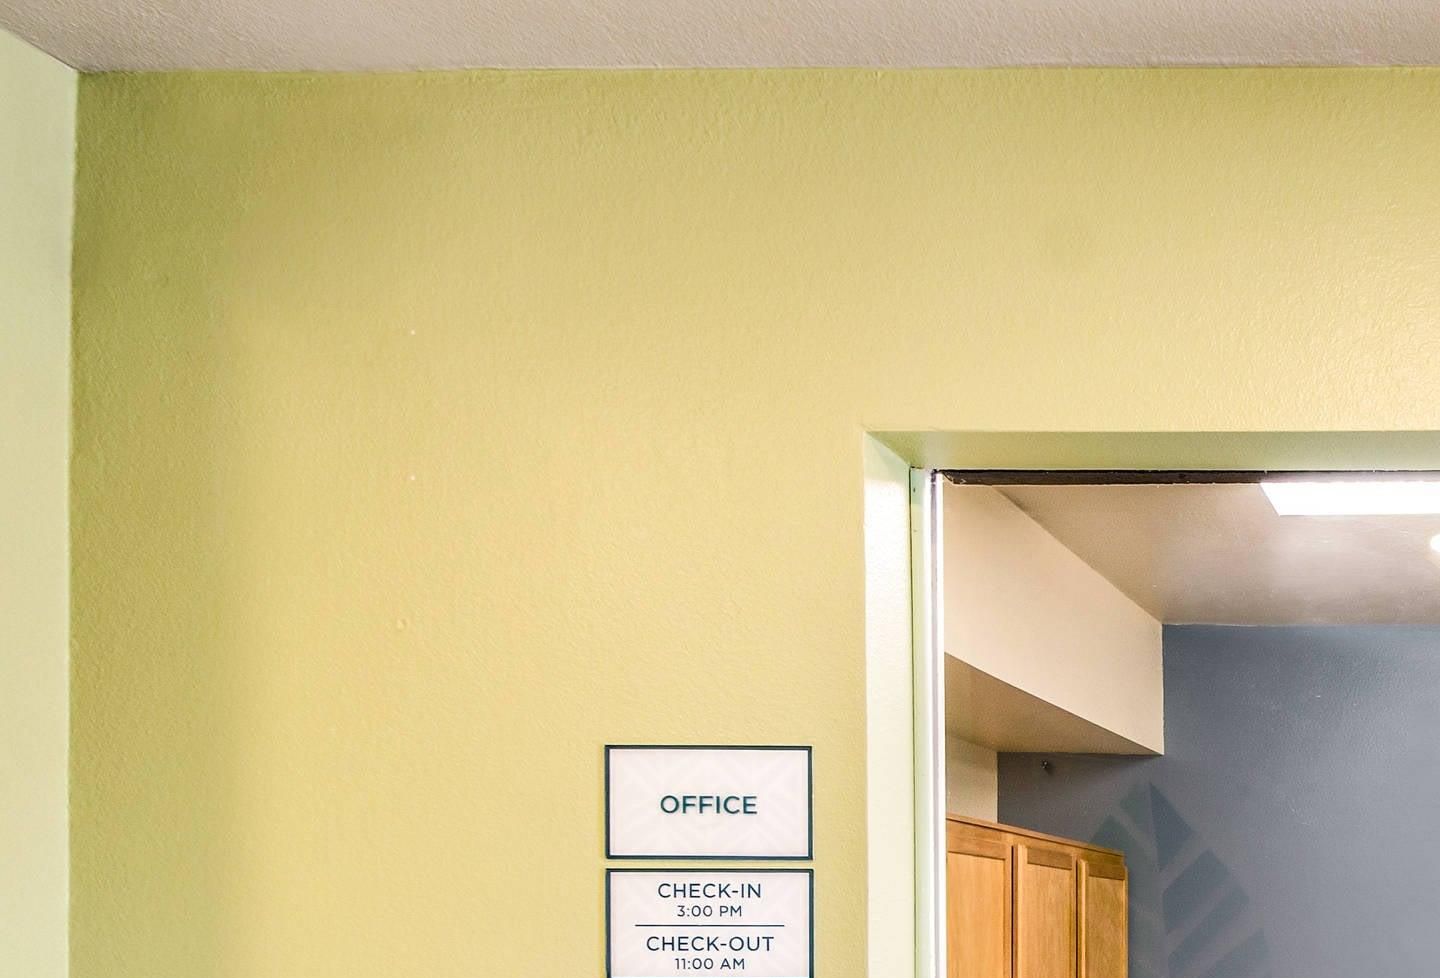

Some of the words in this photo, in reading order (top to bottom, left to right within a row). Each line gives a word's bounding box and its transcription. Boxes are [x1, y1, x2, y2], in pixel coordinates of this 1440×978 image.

[660, 795, 758, 815] OFFICE
[657, 883, 762, 899] CHECK-IN
[677, 905, 713, 917] 3:00
[719, 906, 742, 917] PM
[646, 936, 774, 952] CHECK-OUT
[674, 958, 714, 970] 11:00
[719, 958, 745, 970] AM
